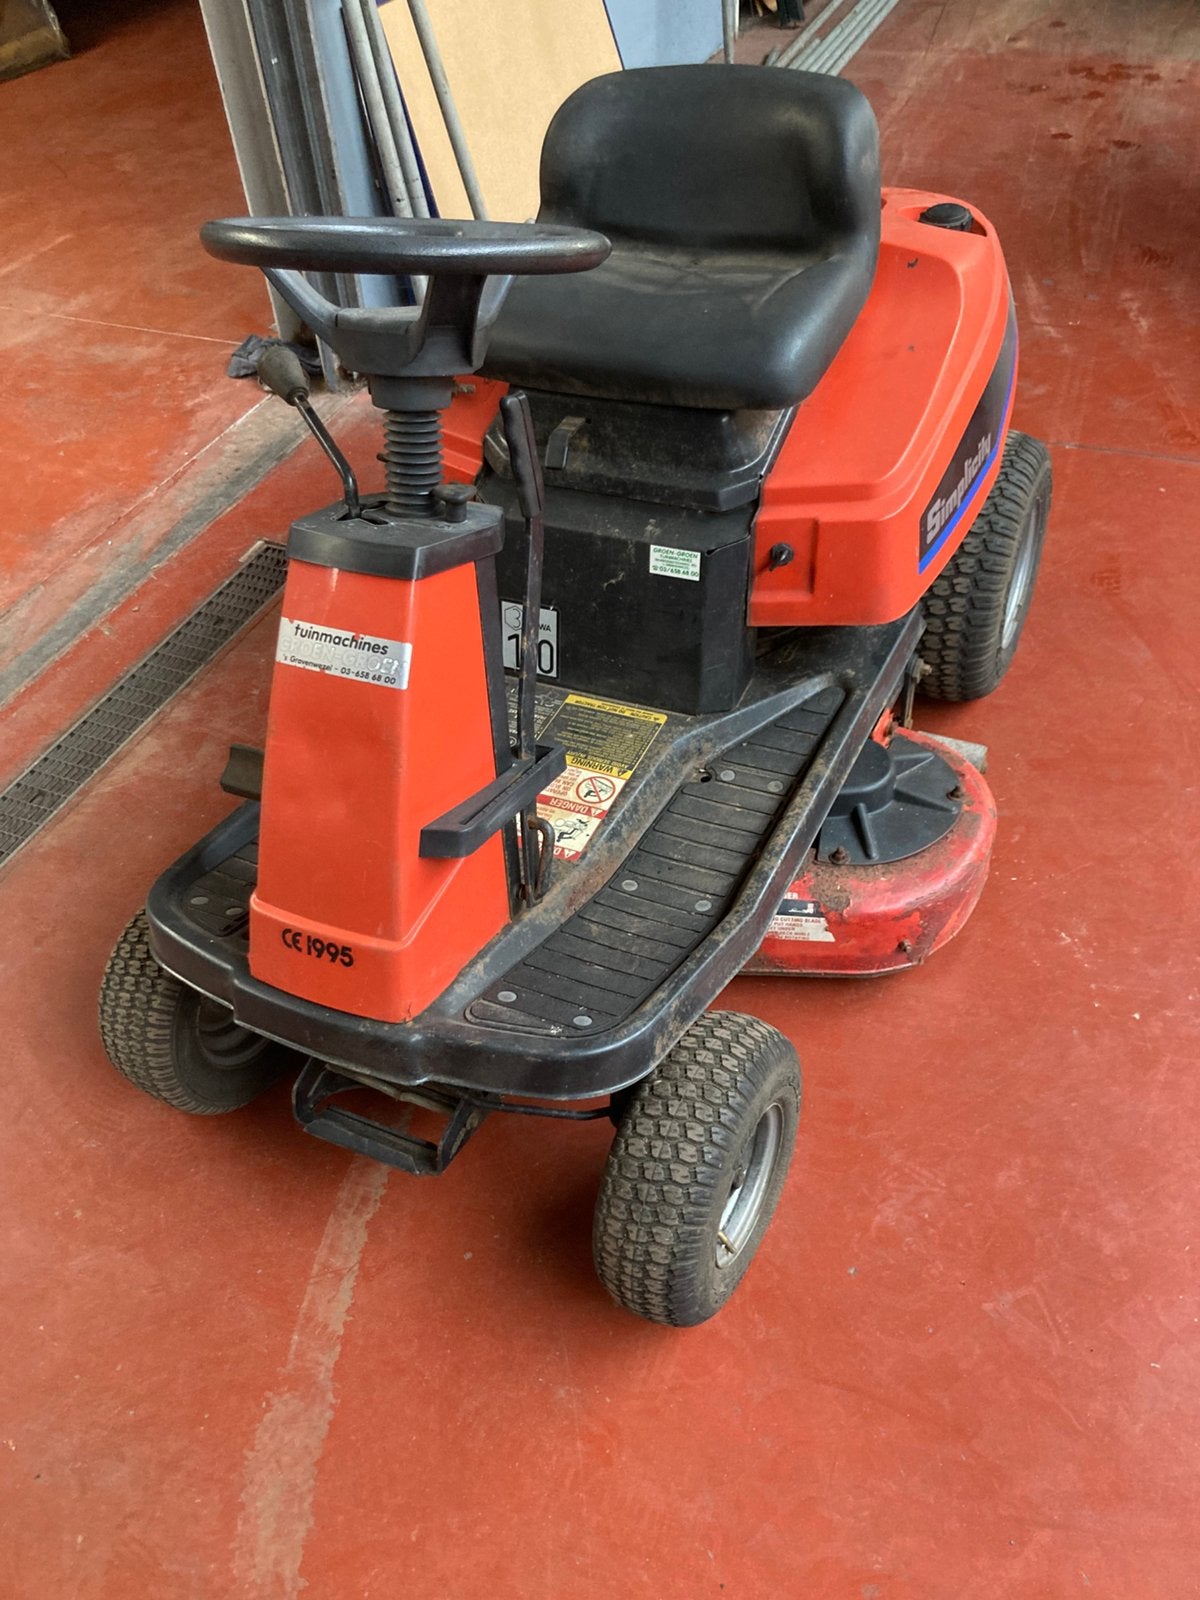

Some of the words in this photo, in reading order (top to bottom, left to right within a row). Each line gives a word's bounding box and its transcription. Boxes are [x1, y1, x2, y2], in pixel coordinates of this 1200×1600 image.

[927, 432, 991, 544] Simplicity
[294, 624, 389, 655] tuinmachines
[539, 624, 552, 632] WA
[508, 633, 554, 674] 10
[340, 667, 370, 680] 03-658
[371, 674, 382, 682] 68
[384, 676, 396, 685] 00
[570, 757, 613, 773] WARNING
[549, 798, 589, 814] DANGER
[281, 928, 302, 953] CE
[306, 935, 354, 968] 1995
